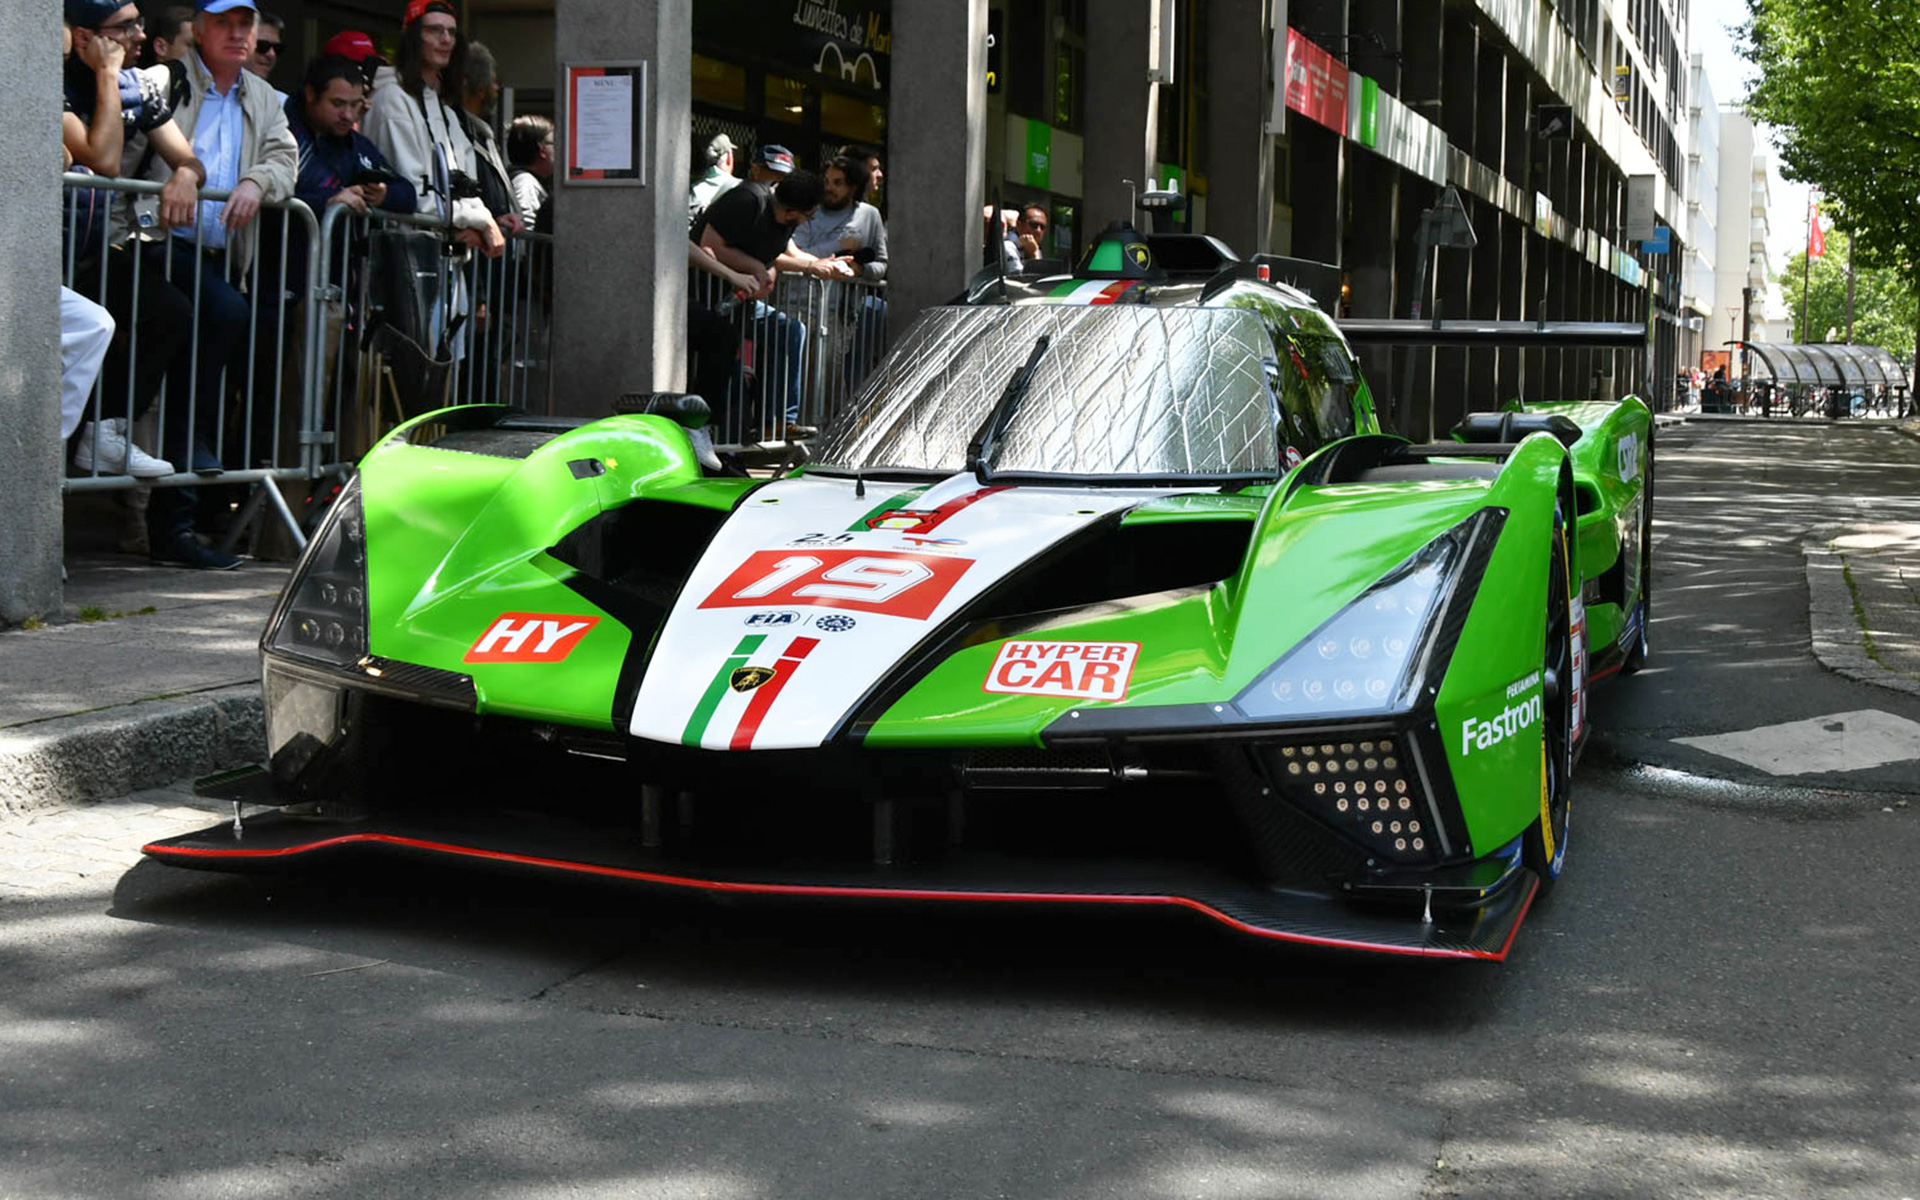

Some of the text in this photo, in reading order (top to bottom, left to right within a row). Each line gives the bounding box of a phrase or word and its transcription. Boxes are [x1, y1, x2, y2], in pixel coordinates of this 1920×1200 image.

[732, 556, 935, 604] 19
[474, 619, 590, 653] HY
[1006, 644, 1128, 662] HYPER
[997, 659, 1121, 693] CAR
[1462, 694, 1541, 757] Fastron
